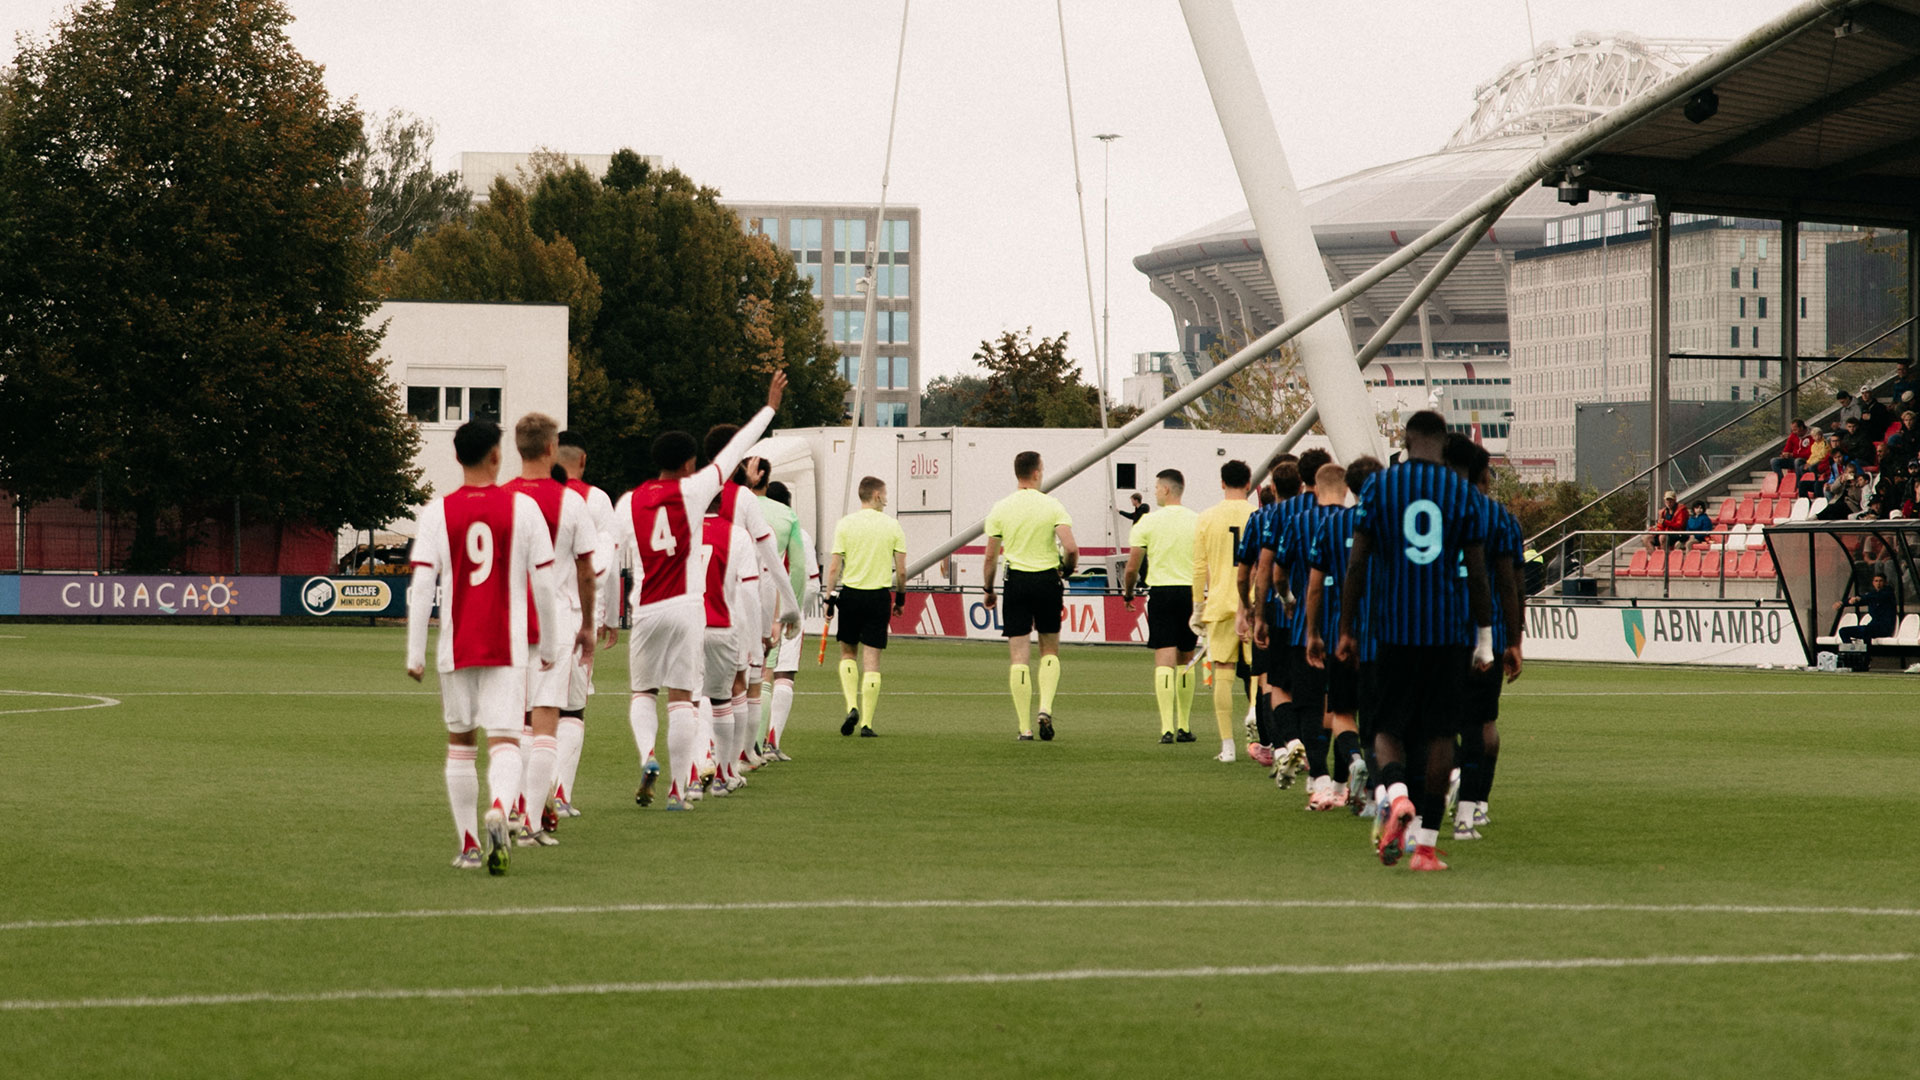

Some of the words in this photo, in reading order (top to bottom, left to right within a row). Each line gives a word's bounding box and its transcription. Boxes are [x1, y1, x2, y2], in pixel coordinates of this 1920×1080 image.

[911, 454, 939, 475] allus
[650, 505, 677, 557] 4
[1403, 499, 1443, 565] 9
[466, 521, 494, 587] 9
[62, 582, 230, 614] CURAÇAO
[340, 598, 355, 607] MINI
[356, 598, 381, 607] OPSLAG
[344, 586, 377, 596] ALLSAFE
